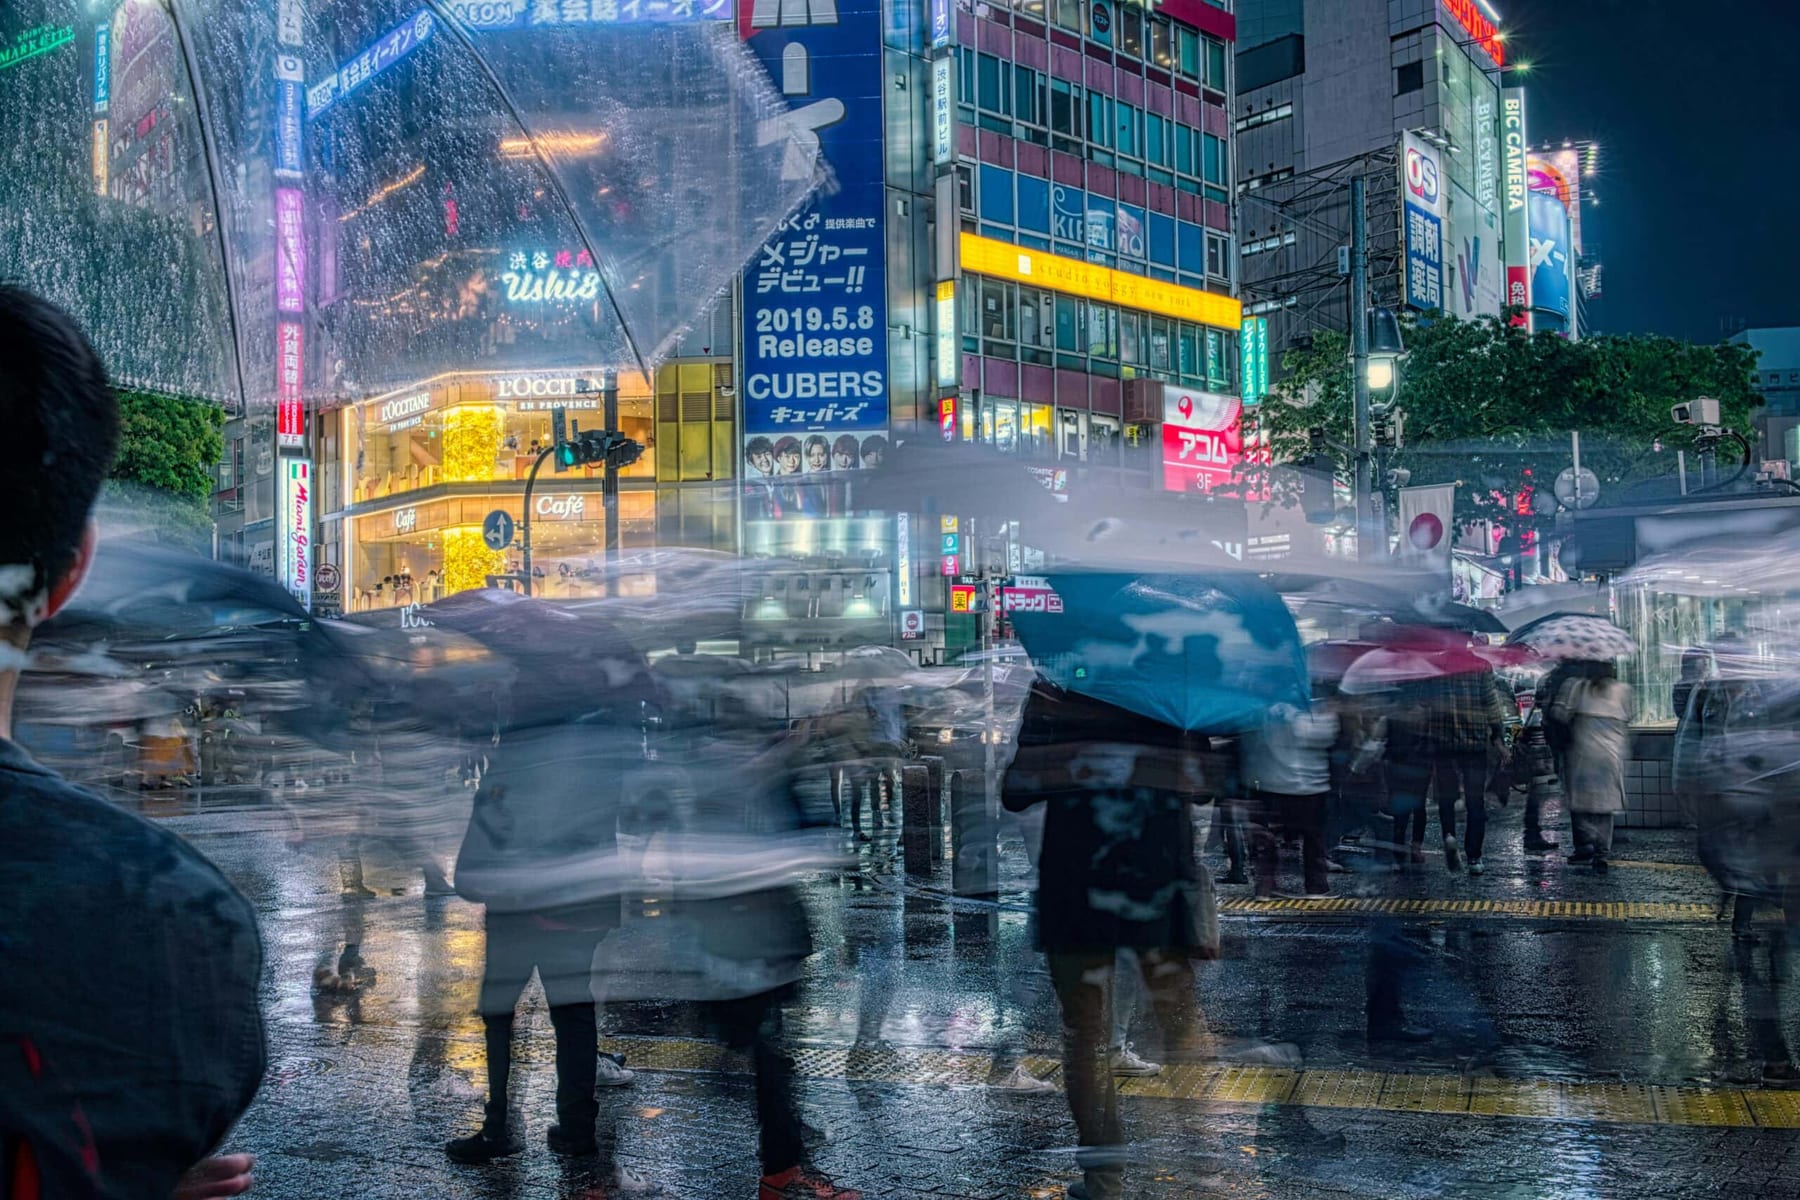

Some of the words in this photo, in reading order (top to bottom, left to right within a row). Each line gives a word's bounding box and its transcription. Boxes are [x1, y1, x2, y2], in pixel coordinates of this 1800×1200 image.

[937, 68, 948, 155] 渋谷駅前ビル
[1504, 98, 1521, 129] BIC
[1408, 149, 1437, 203] OS
[1506, 132, 1524, 210] CAMERA
[824, 218, 876, 230] 提供楽曲で
[1410, 210, 1438, 262] 調剤
[509, 251, 550, 270] 渋谷
[760, 234, 868, 267] メジャー
[502, 270, 600, 301] Ushi8
[757, 266, 865, 293] デビュー!!
[1040, 264, 1089, 284] studio
[1412, 258, 1439, 308] 薬局
[756, 306, 874, 332] 2019.5.8
[759, 333, 873, 358] Release
[499, 377, 605, 397] L'OCCITN
[747, 370, 883, 399] CUBERS
[382, 393, 430, 421] L'OCCITANE
[770, 402, 869, 423] キューバーズ
[284, 434, 297, 444] 7F
[1178, 431, 1227, 464] アコム
[1196, 472, 1213, 490] 3F
[396, 508, 416, 531] Café
[537, 495, 583, 519] Café
[962, 576, 974, 585] TAX
[1003, 593, 1046, 612] ドラッグ
